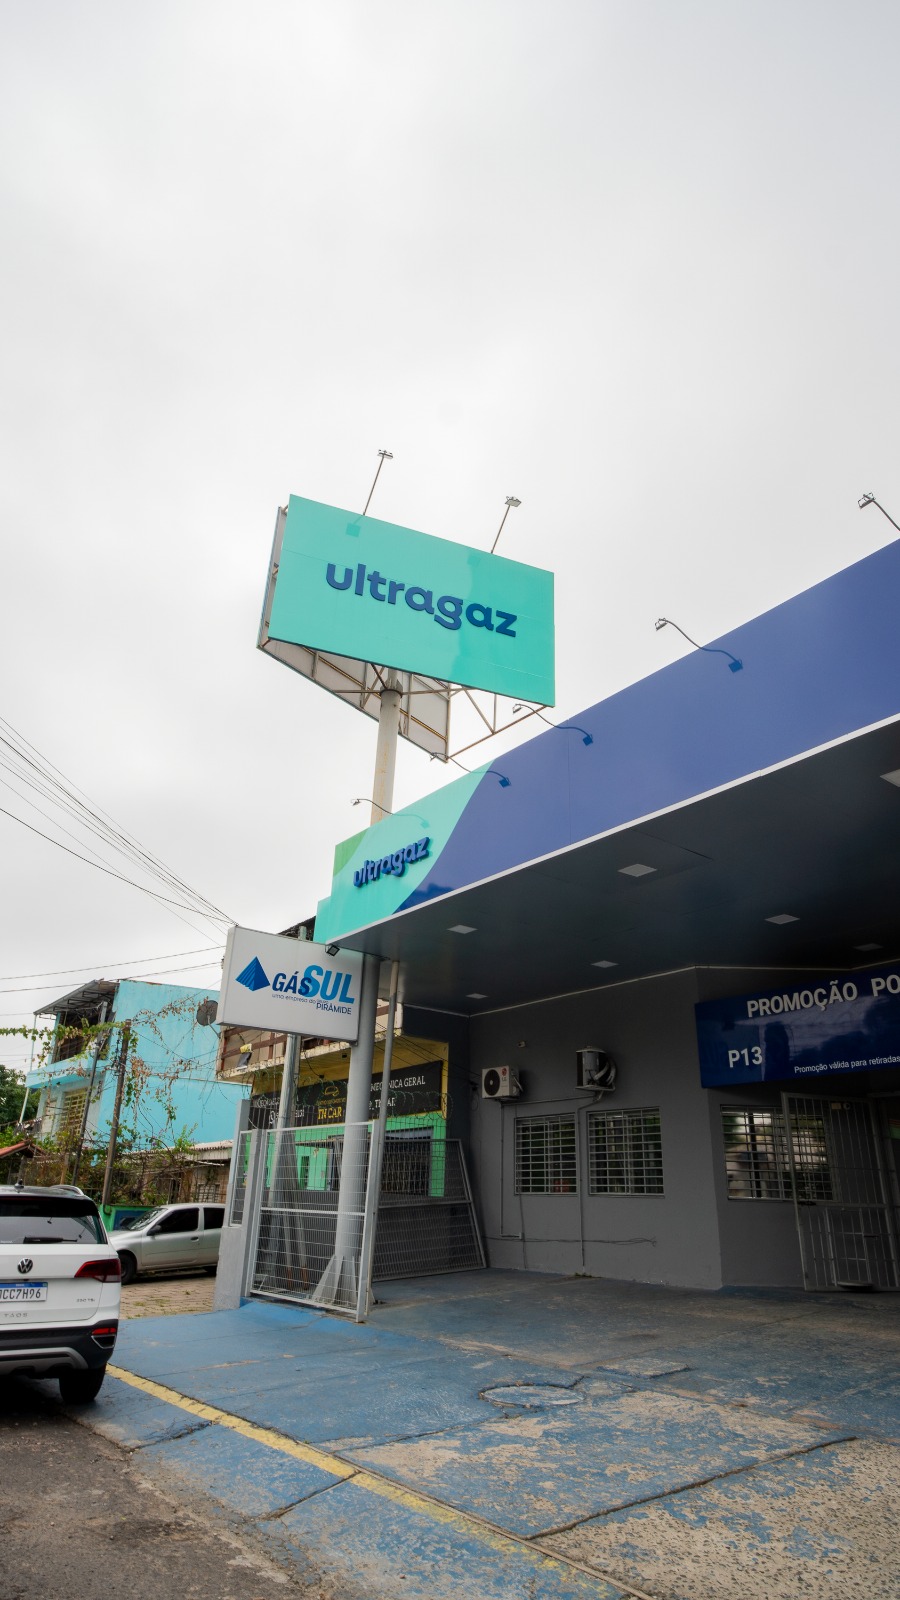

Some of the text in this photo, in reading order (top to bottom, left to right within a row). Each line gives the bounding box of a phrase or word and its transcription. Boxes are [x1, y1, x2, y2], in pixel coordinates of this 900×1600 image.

[325, 562, 518, 638] ultragaz
[353, 836, 431, 888] ultragaz
[747, 979, 858, 1018] PROMOÇÃO
[316, 1002, 352, 1015] PIRÂMIDE
[727, 1046, 763, 1068] P13
[794, 1063, 828, 1074] Promoção
[829, 1060, 850, 1070] válida
[850, 1059, 868, 1069] para
[403, 1076, 426, 1088] GERAL
[0, 1288, 41, 1300] CC7H96
